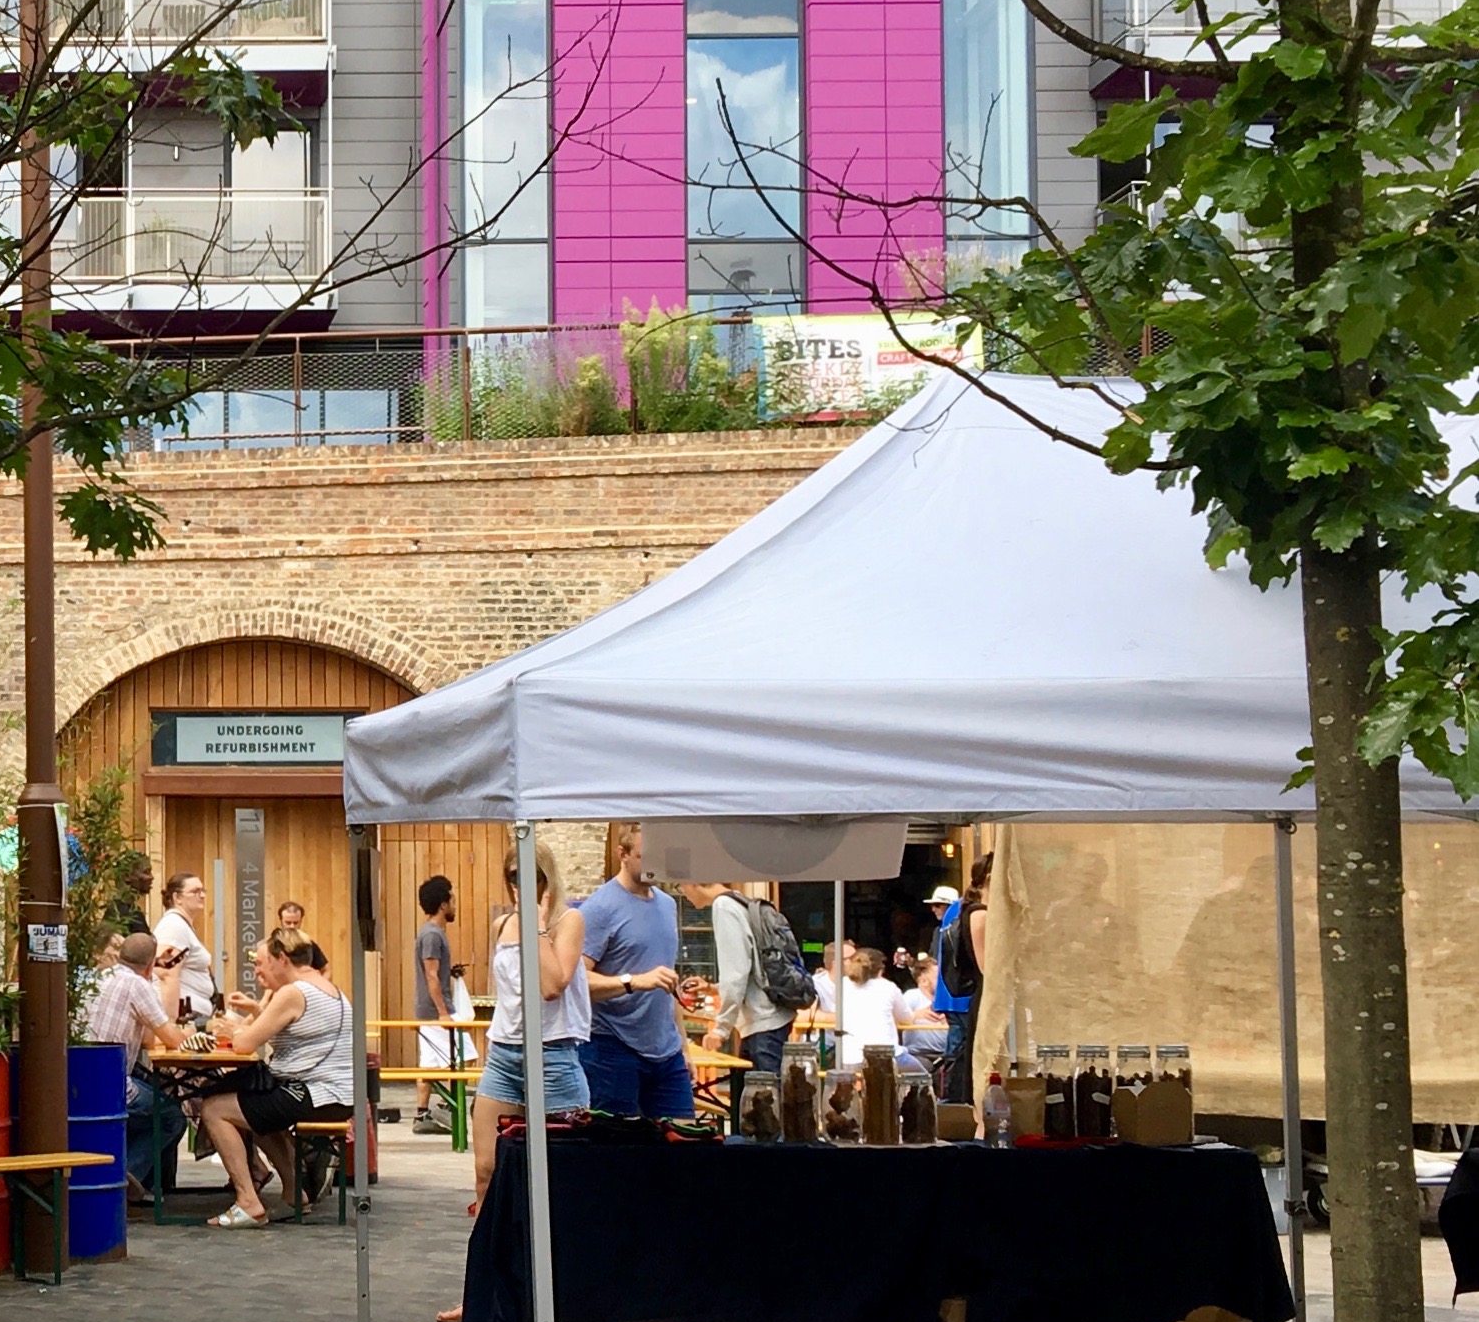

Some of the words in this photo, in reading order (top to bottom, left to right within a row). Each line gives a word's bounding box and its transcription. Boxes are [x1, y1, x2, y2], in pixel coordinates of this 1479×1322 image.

[774, 338, 862, 361] BITES
[777, 375, 861, 389] ATURDAY
[217, 725, 304, 736] UNDERGOING
[205, 742, 316, 754] REFURBISHMENT
[239, 811, 260, 833] 11
[242, 862, 259, 874] 4
[242, 879, 261, 952] Market
